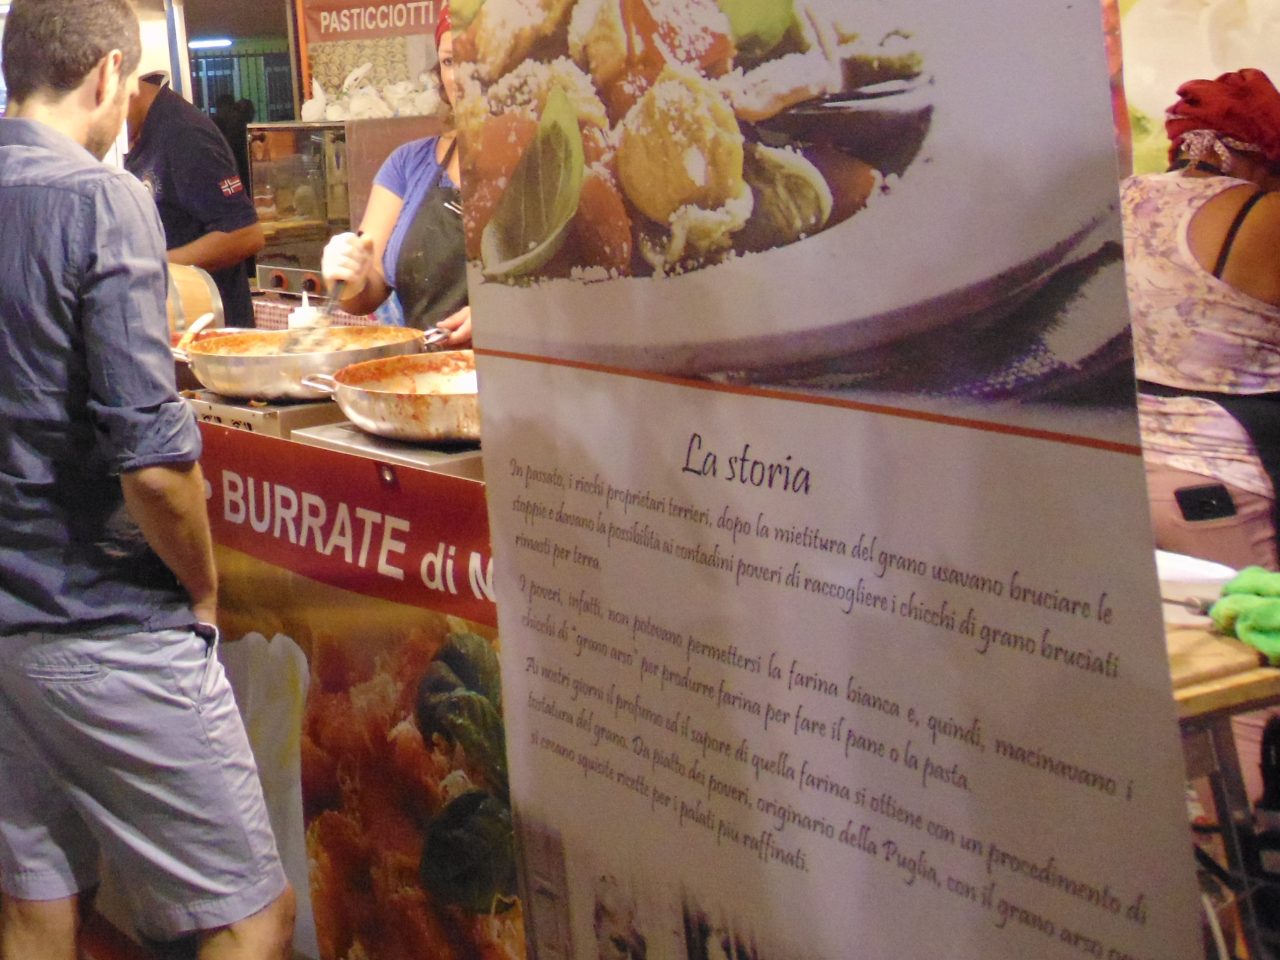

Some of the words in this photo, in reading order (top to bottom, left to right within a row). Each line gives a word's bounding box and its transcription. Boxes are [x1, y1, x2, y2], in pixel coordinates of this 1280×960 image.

[320, 0, 434, 34] PASTICCIOTTI
[222, 469, 410, 581] BURRATE
[420, 542, 457, 594] di
[682, 432, 718, 477] La
[725, 443, 813, 496] storia
[552, 542, 570, 566] per
[575, 473, 604, 494] ricchi
[606, 484, 665, 515] proprietari
[669, 497, 713, 528] terrieri,
[717, 505, 751, 544] dopo
[756, 512, 770, 538] la
[775, 526, 846, 555] mietitura
[851, 533, 877, 562] del
[874, 550, 927, 579] grano
[932, 563, 1003, 597] usavano
[1009, 570, 1091, 619] bruciare
[1097, 592, 1113, 624] le
[596, 511, 607, 535] la
[662, 539, 673, 555] ai
[675, 544, 735, 573] contadini
[736, 557, 783, 586] poveri
[785, 562, 800, 588] di
[804, 577, 888, 614] raccogliere
[891, 595, 897, 614] i
[900, 591, 956, 631] chicchi
[959, 607, 977, 637] di
[975, 624, 1036, 655] grano
[1041, 628, 1120, 678] bruciati
[528, 580, 563, 606] poveri,
[608, 610, 629, 626] non
[633, 615, 683, 645] potevano
[686, 634, 761, 673] permettersi
[767, 652, 782, 680] la
[788, 659, 839, 697] farina
[846, 675, 901, 717] bianca
[907, 706, 920, 727] e,
[927, 717, 986, 754] quindi,
[995, 739, 1117, 797] macinavano
[1126, 779, 1135, 801] i
[558, 620, 568, 641] di
[640, 656, 659, 683] per
[662, 666, 720, 698] produrre
[717, 679, 761, 716] farina
[764, 703, 791, 731] per
[795, 704, 827, 737] fare
[831, 715, 845, 742] il
[845, 728, 885, 759] pane
[889, 747, 899, 763] o
[904, 740, 919, 771] la
[575, 708, 594, 733] del
[688, 758, 705, 787] dei
[707, 774, 752, 810] poveri,
[757, 796, 835, 839] originario
[838, 819, 877, 856] della
[881, 839, 942, 888] Puglia,
[946, 876, 977, 903] con
[981, 882, 996, 910] il
[995, 897, 1056, 937] grano
[652, 788, 671, 812] per
[680, 799, 715, 831] palati
[681, 715, 691, 738] il
[691, 727, 731, 758] sapore
[734, 738, 748, 763] di
[751, 751, 795, 782] quella
[799, 760, 851, 800] farina
[854, 787, 867, 808] si
[870, 792, 922, 830] ottiene
[927, 820, 956, 844] con
[960, 834, 984, 856] un
[986, 842, 1121, 914] procedimento
[1125, 893, 1147, 925] di
